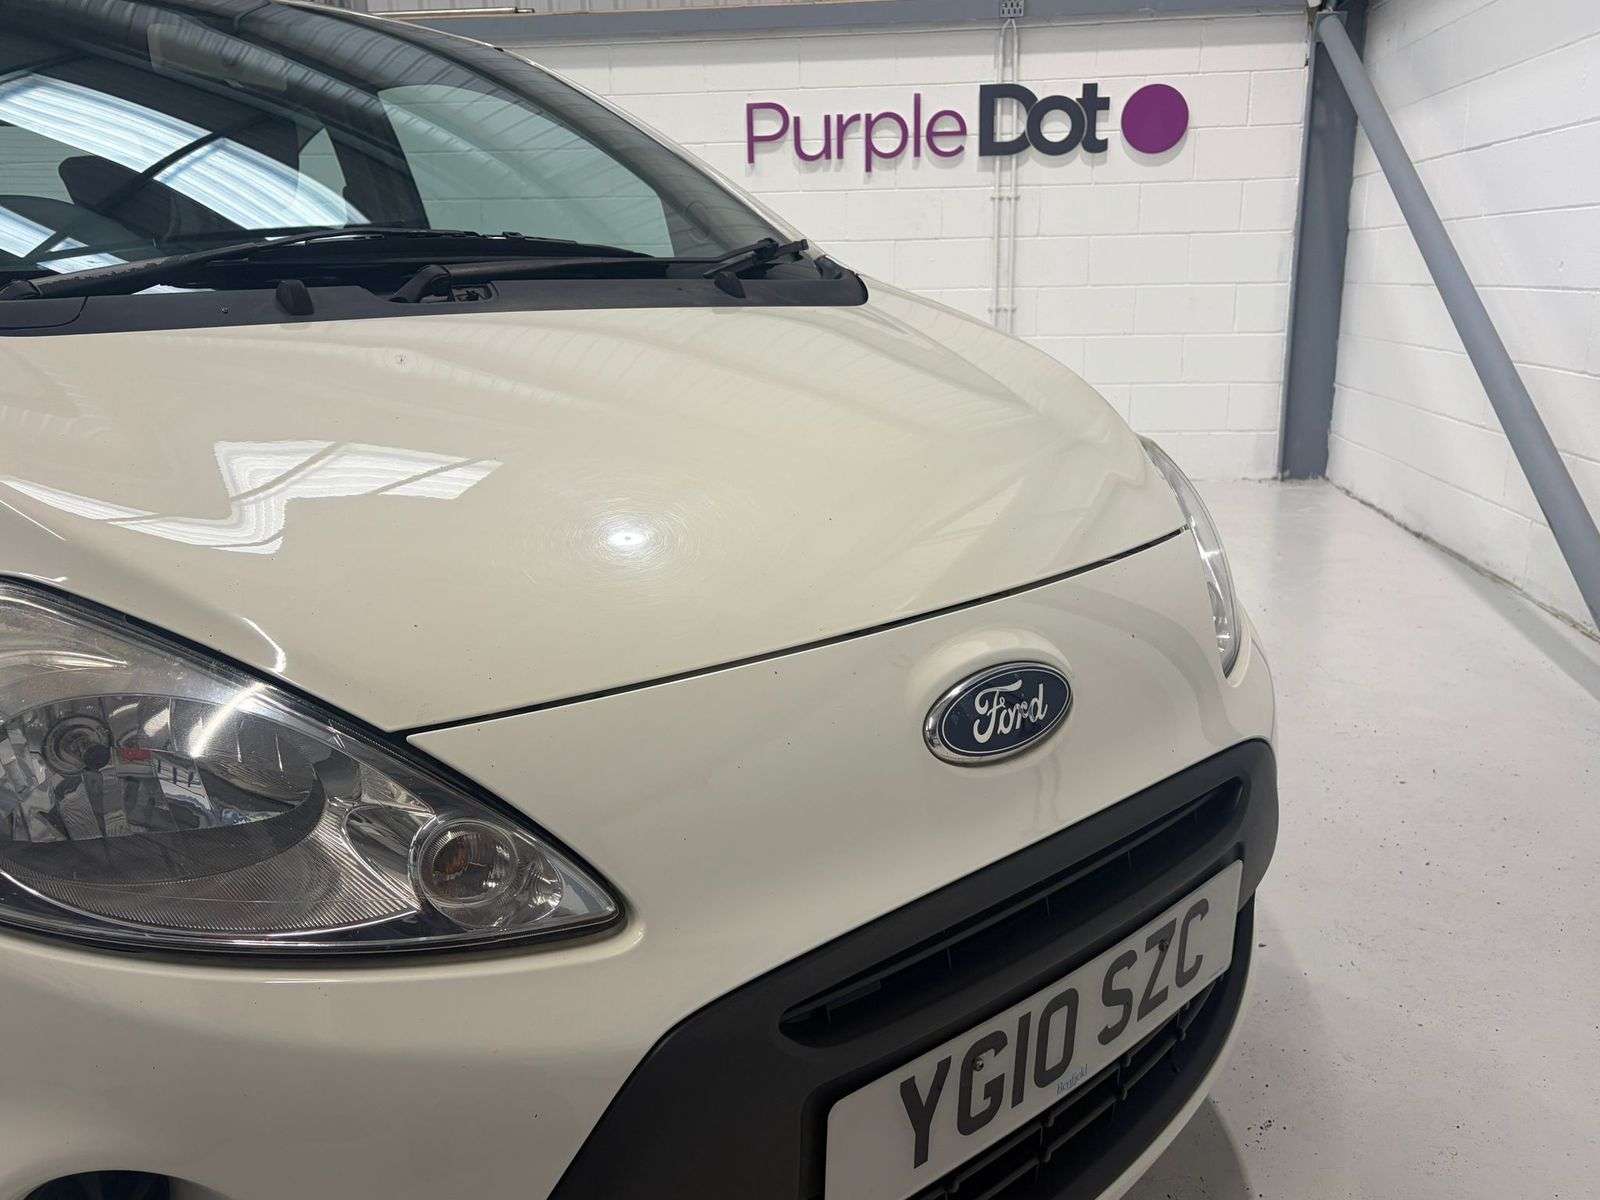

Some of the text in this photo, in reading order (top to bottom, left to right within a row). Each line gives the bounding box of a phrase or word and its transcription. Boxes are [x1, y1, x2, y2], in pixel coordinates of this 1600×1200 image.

[745, 83, 1110, 172] Purple Dot
[973, 679, 1048, 743] Ford
[900, 898, 1209, 1168] YG10 SZC
